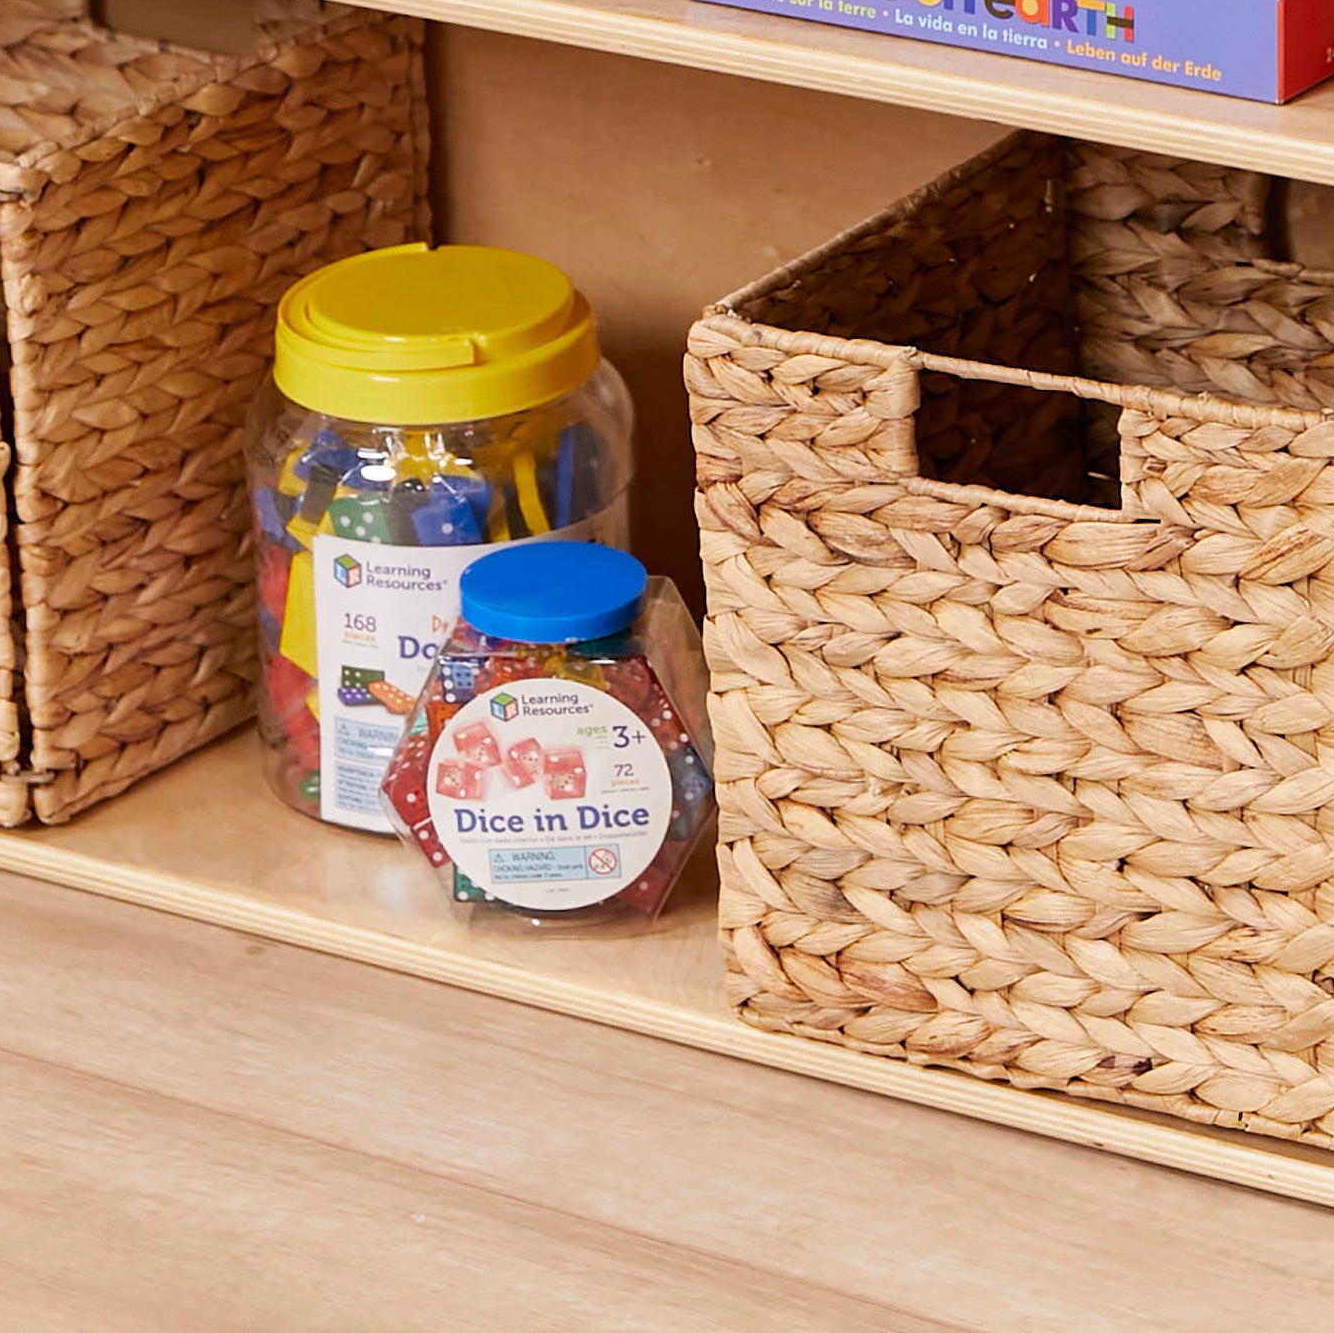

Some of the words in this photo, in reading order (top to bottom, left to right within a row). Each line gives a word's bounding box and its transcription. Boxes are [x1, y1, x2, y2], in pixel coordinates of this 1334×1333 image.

[837, 0, 877, 19] terre
[895, 8, 914, 26] La
[918, 14, 954, 33] vida
[958, 22, 979, 38] en
[982, 25, 999, 41] la
[1002, 27, 1048, 50] tierra
[1067, 39, 1116, 62] Leben
[1120, 50, 1147, 67] auf
[1152, 54, 1180, 74] der
[1184, 60, 1223, 81] Erde
[366, 561, 432, 581] Learning
[343, 612, 377, 633] 168
[522, 693, 579, 705] Learning
[576, 725, 608, 737] ages
[612, 725, 646, 749] 3+
[613, 763, 635, 777] 72
[454, 808, 524, 833] Dice
[534, 808, 568, 832] in
[576, 804, 649, 830] Dice
